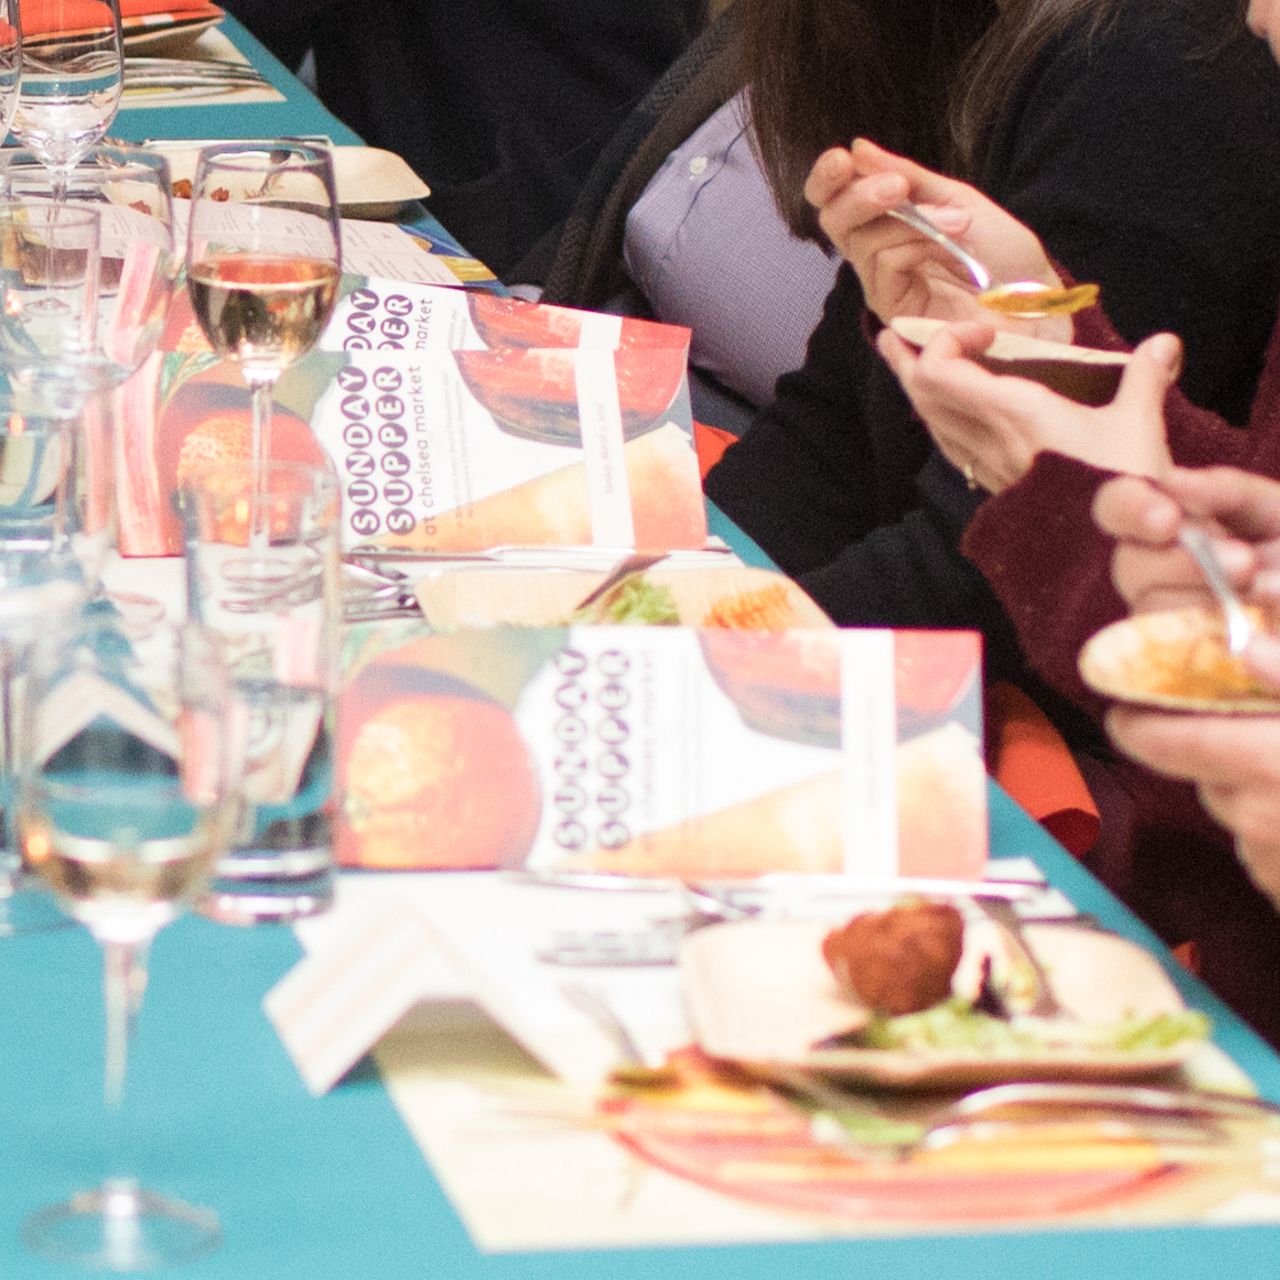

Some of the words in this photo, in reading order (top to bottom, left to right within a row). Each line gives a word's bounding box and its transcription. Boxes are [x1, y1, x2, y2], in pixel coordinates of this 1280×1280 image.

[337, 365, 381, 536] SUNDAY
[372, 364, 417, 536] SUPPER
[408, 364, 424, 432] market
[417, 439, 434, 509] chelsea
[424, 515, 438, 536] at
[553, 646, 588, 851] SUNDAY
[596, 648, 630, 851] SUPPER
